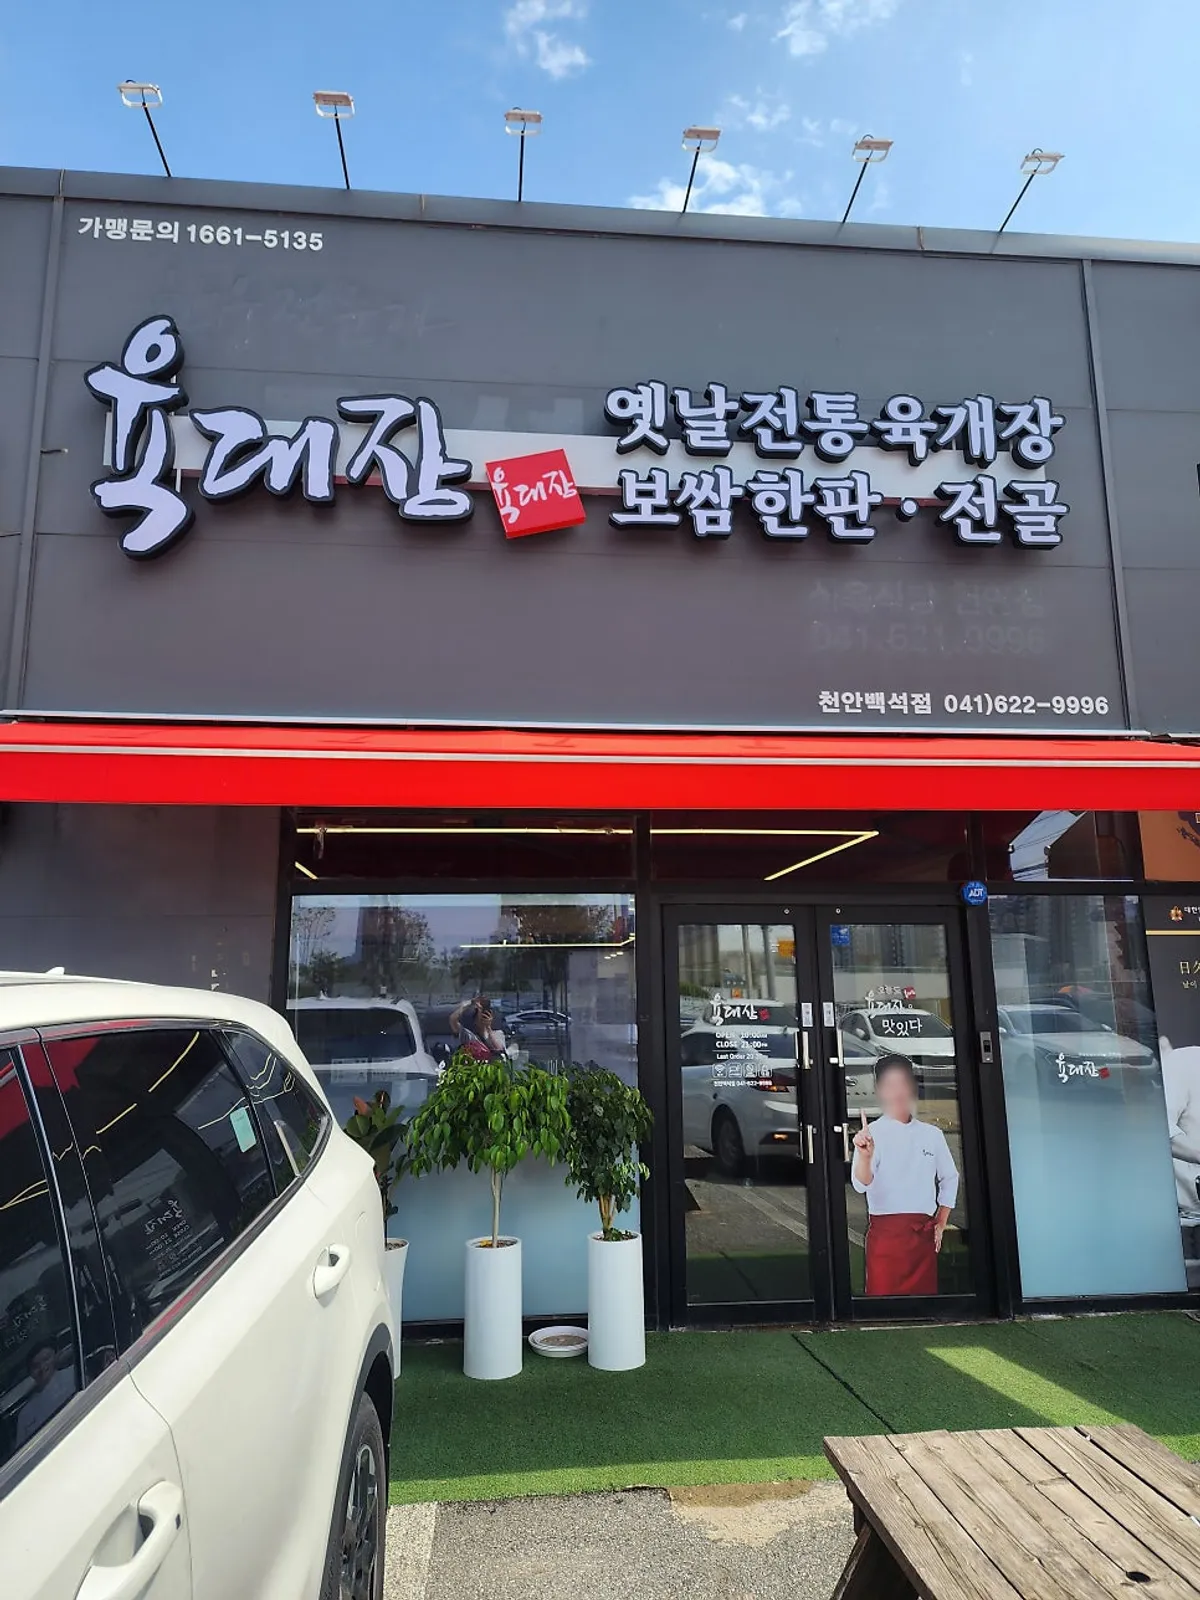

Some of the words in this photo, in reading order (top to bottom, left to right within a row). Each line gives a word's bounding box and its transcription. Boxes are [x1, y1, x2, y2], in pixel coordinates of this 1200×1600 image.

[78, 217, 180, 243] 가맹문의
[187, 223, 323, 251] 1661-5135
[84, 315, 473, 560] 육대장
[491, 467, 577, 524] 육대장
[934, 473, 1070, 550] 전골
[818, 690, 932, 714] 천안백석점
[944, 692, 1109, 716] 041)622-9996
[969, 888, 984, 897] ADT
[1184, 906, 1200, 915] 대한
[710, 992, 759, 1026] 육대장
[882, 1017, 923, 1036] 맛있다
[715, 1041, 738, 1049] CLOSE
[1055, 1052, 1099, 1083] 육대장
